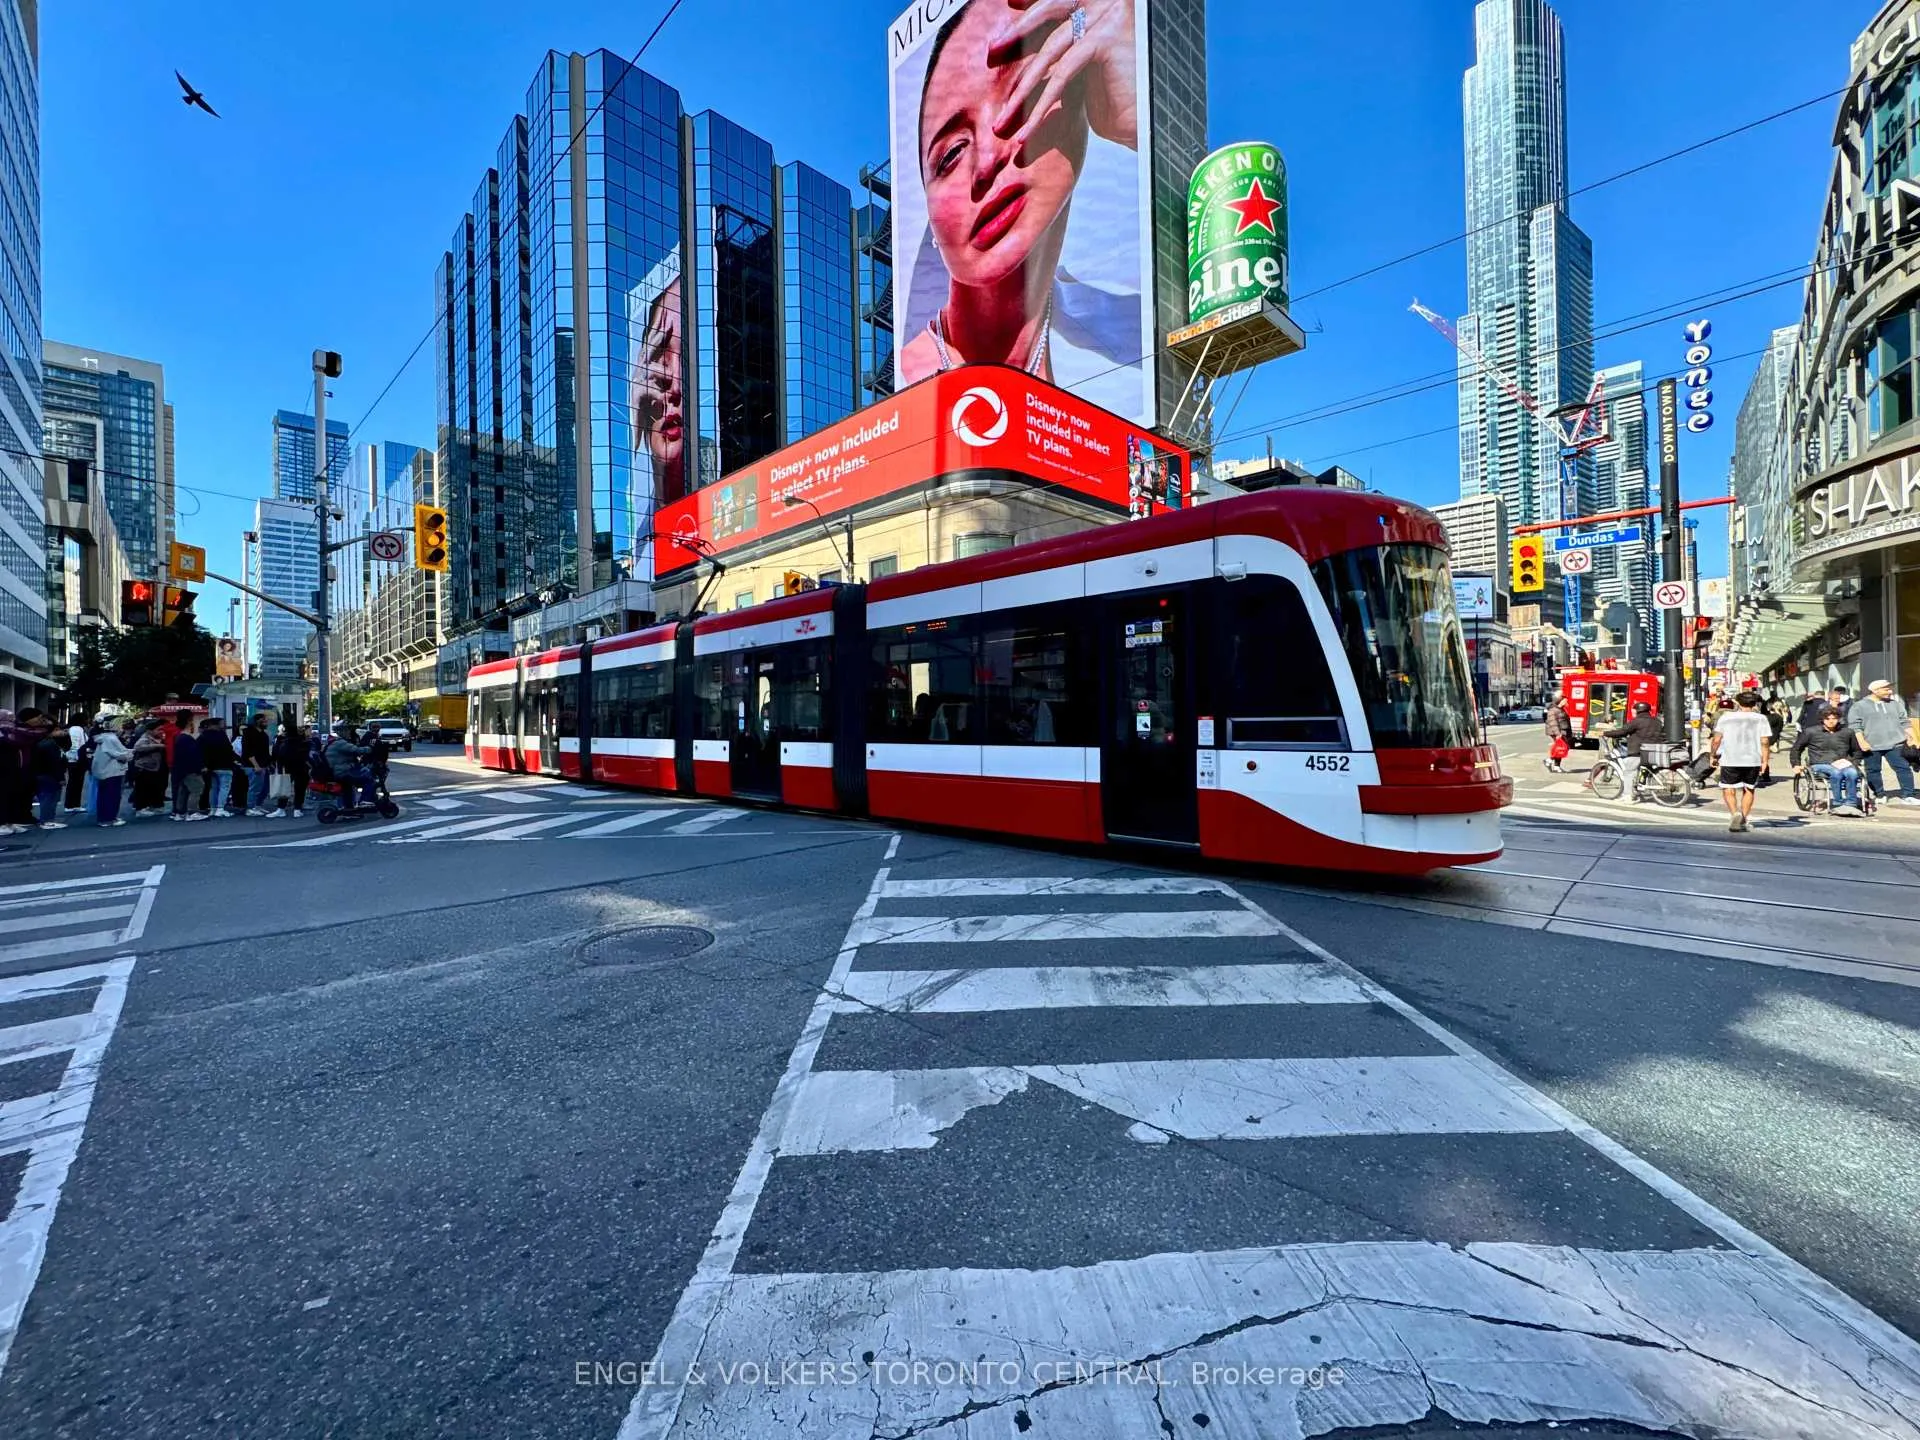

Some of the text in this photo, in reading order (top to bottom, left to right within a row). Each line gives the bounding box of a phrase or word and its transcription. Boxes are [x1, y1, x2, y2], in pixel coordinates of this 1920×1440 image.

[894, 0, 953, 58] MIO
[1685, 319, 1711, 432] Yonge
[1026, 392, 1091, 431] Disney+ now
[1026, 411, 1110, 456] included in select
[1662, 384, 1675, 463] DOWNTOWN
[770, 411, 899, 483] Disney+ now included
[1026, 429, 1072, 458] TV plans.
[782, 475, 814, 498] select
[816, 465, 831, 483] TV
[833, 455, 869, 483] plans.
[1568, 532, 1615, 547] Dundas
[1305, 754, 1350, 771] 4552
